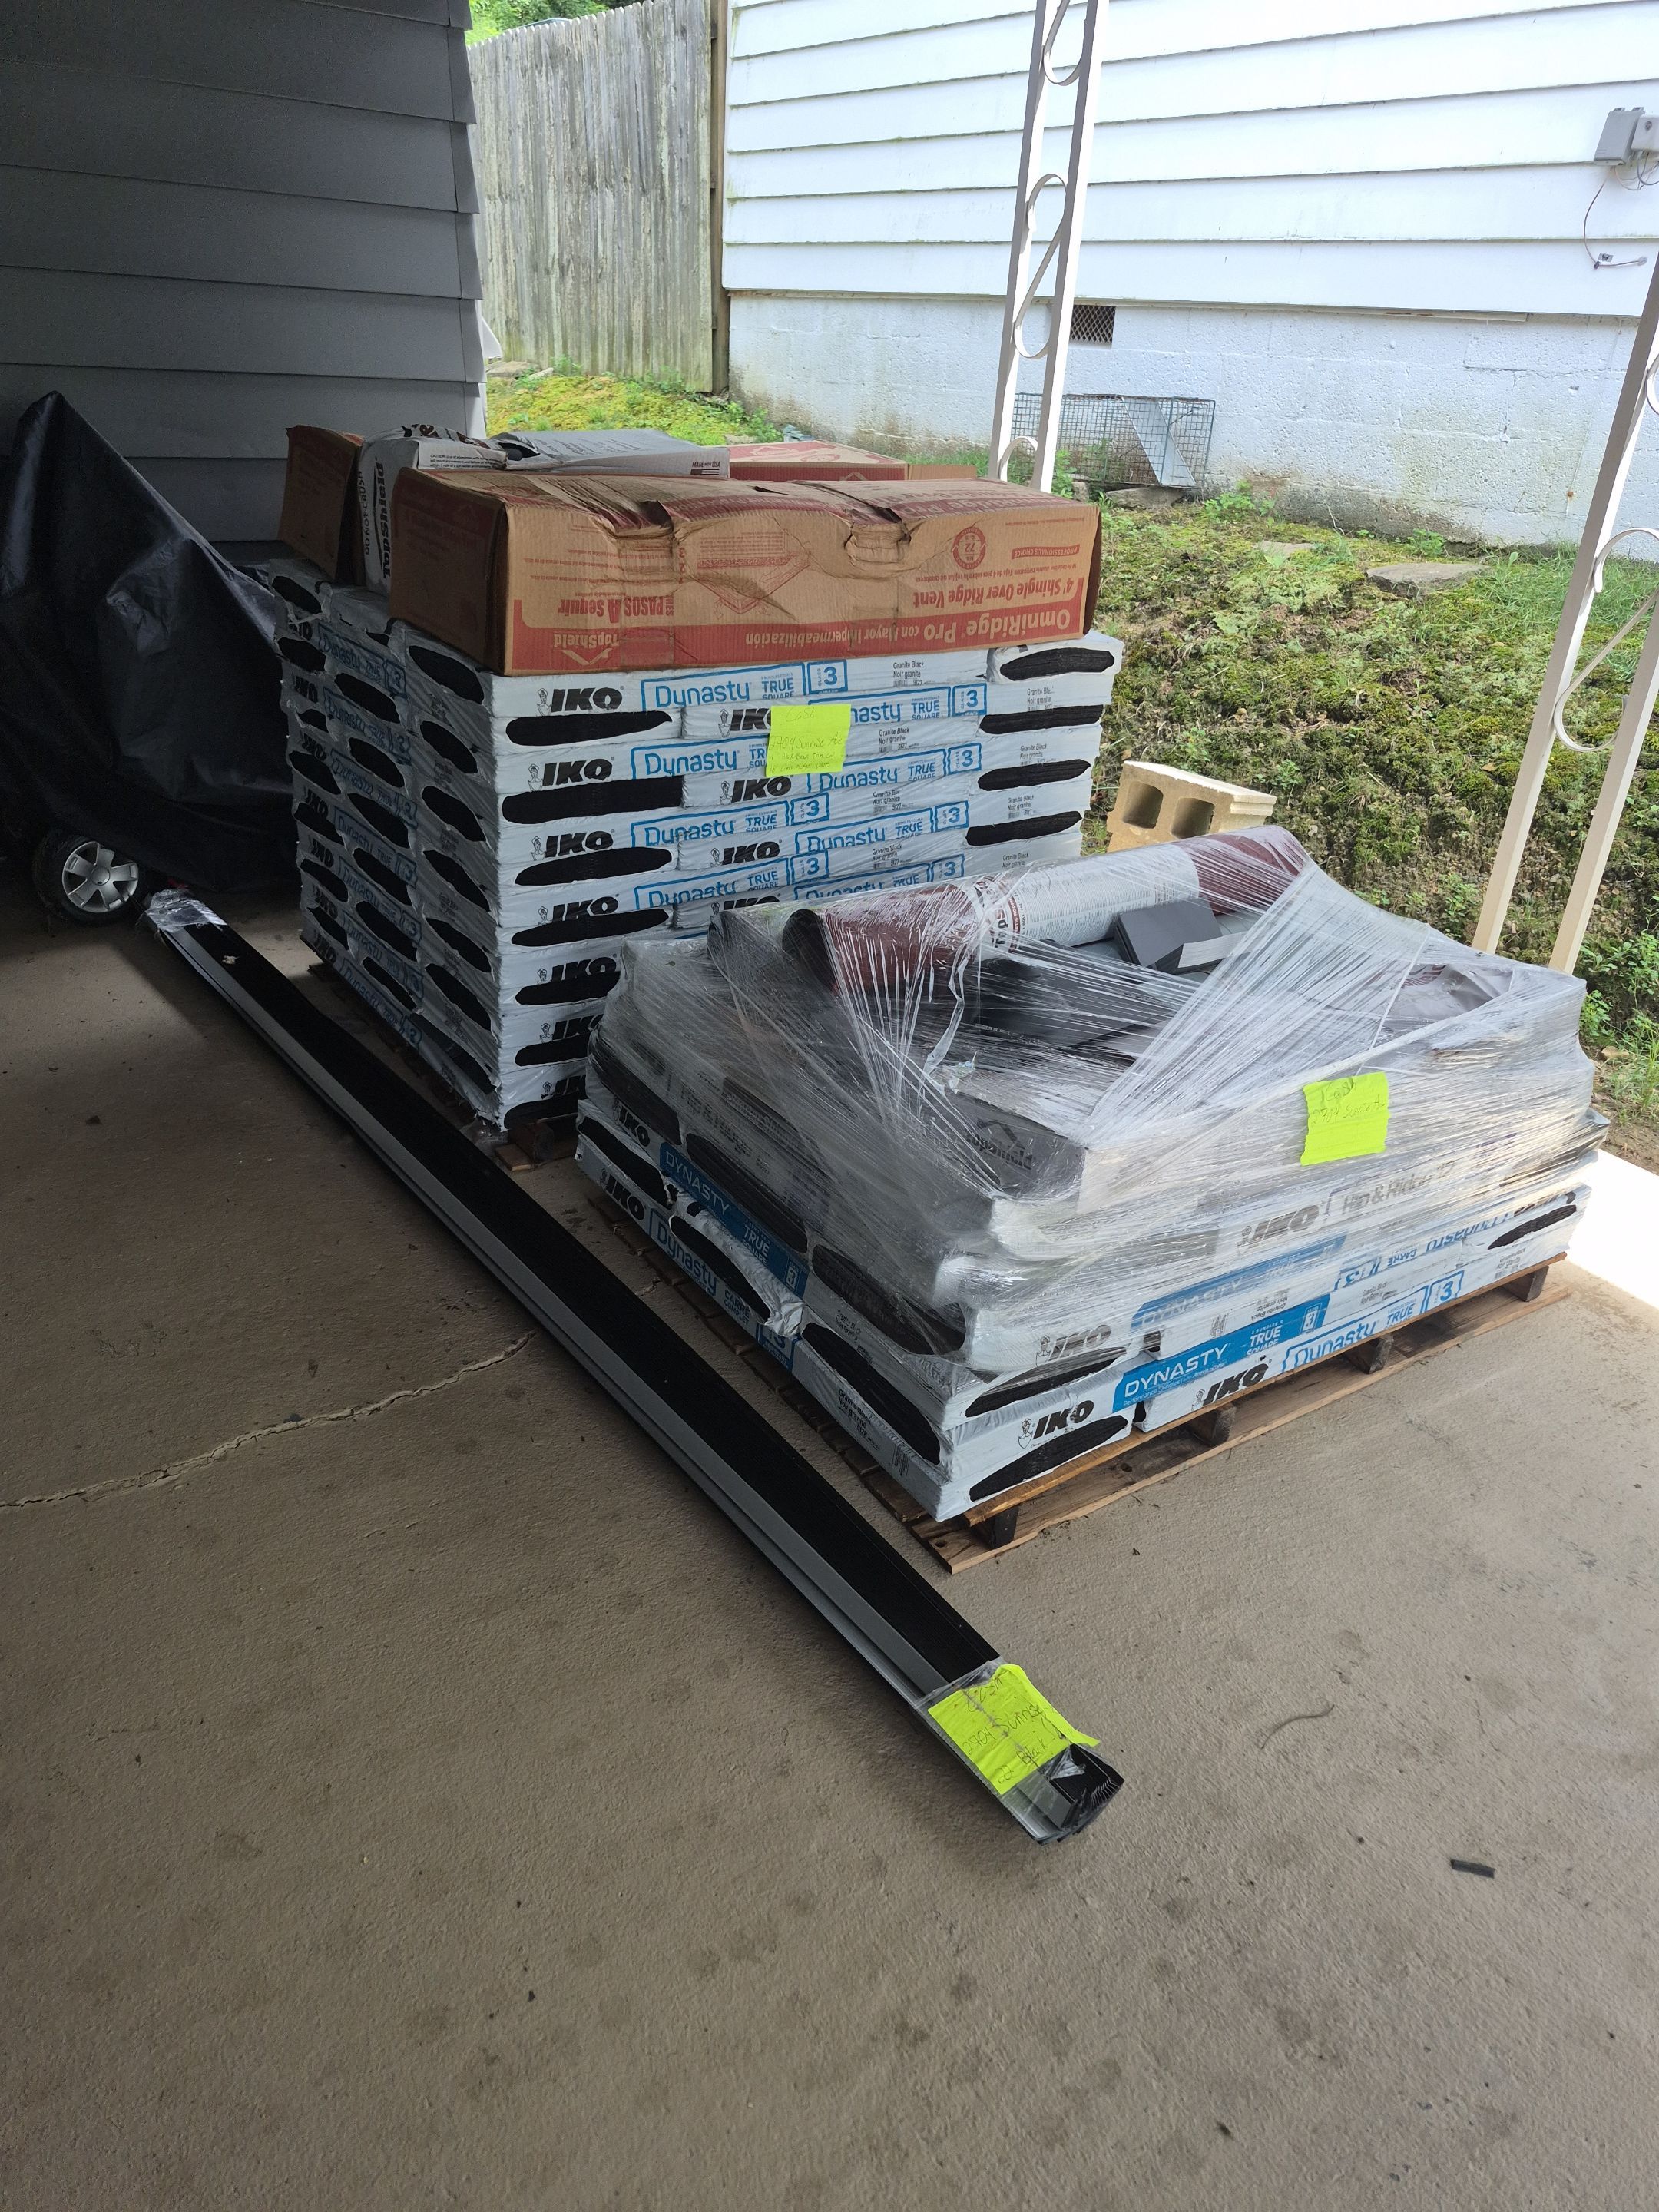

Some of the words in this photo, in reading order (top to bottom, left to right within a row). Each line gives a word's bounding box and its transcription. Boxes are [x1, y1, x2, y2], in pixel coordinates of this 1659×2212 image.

[965, 543, 975, 553] 72
[913, 589, 945, 608] Vent
[948, 584, 985, 607] Ridge
[986, 585, 1015, 601] Over
[1017, 578, 1062, 600] Shingle
[607, 599, 623, 624] A
[624, 597, 664, 617] PASOS
[864, 624, 899, 642] Mayor
[901, 625, 920, 638] con
[923, 621, 957, 644] Pro
[966, 608, 1071, 640] OmniRidge
[554, 632, 619, 649] TopShield
[893, 661, 911, 670] Granite
[904, 670, 922, 679] granite
[763, 676, 795, 694] TRUE
[823, 667, 838, 686] 3
[551, 687, 623, 713] IKO
[655, 680, 750, 707] Dynasty
[966, 690, 979, 707] 3
[911, 700, 940, 714] TRUE
[730, 708, 771, 731] IK
[851, 704, 901, 723] nasty
[879, 728, 896, 737] Granite
[896, 727, 910, 736] Black
[889, 735, 906, 745] granite
[749, 748, 768, 761] TR
[961, 750, 973, 767] 3
[542, 757, 614, 786] IKO
[644, 748, 738, 777] Dynasty
[748, 760, 767, 769] SQU
[908, 762, 936, 777] TRUE
[731, 775, 792, 803] IKO
[819, 766, 899, 792] Dynasty
[806, 800, 820, 816] 3
[949, 807, 961, 823] 3
[745, 813, 777, 828] TRUE
[895, 821, 923, 834] TRUE
[545, 830, 614, 859] IKO
[644, 820, 735, 847] Dynasty
[722, 841, 780, 865] IKO
[807, 827, 886, 854] Dynasty
[806, 857, 820, 875] 3
[943, 862, 956, 876] 3
[747, 870, 779, 886] TRUE
[553, 896, 619, 922] IKO
[552, 956, 617, 982] IKO
[619, 1105, 651, 1147] IKO
[665, 1150, 730, 1215] DYNASTY
[605, 1174, 646, 1221] IKO
[657, 1220, 719, 1296] Dynasty
[743, 1227, 770, 1259] TRUE
[785, 1266, 799, 1288] 3
[1439, 1280, 1454, 1302] 3
[1305, 1311, 1316, 1328] 3
[1387, 1302, 1416, 1326] TRUE
[1250, 1324, 1283, 1347] TRUE
[1203, 1363, 1269, 1406] IKO
[1294, 1320, 1378, 1368] Dynasty
[1034, 1400, 1094, 1440] IKO
[1124, 1342, 1231, 1399] DYNASTY
[1015, 1737, 1049, 1765] Black
